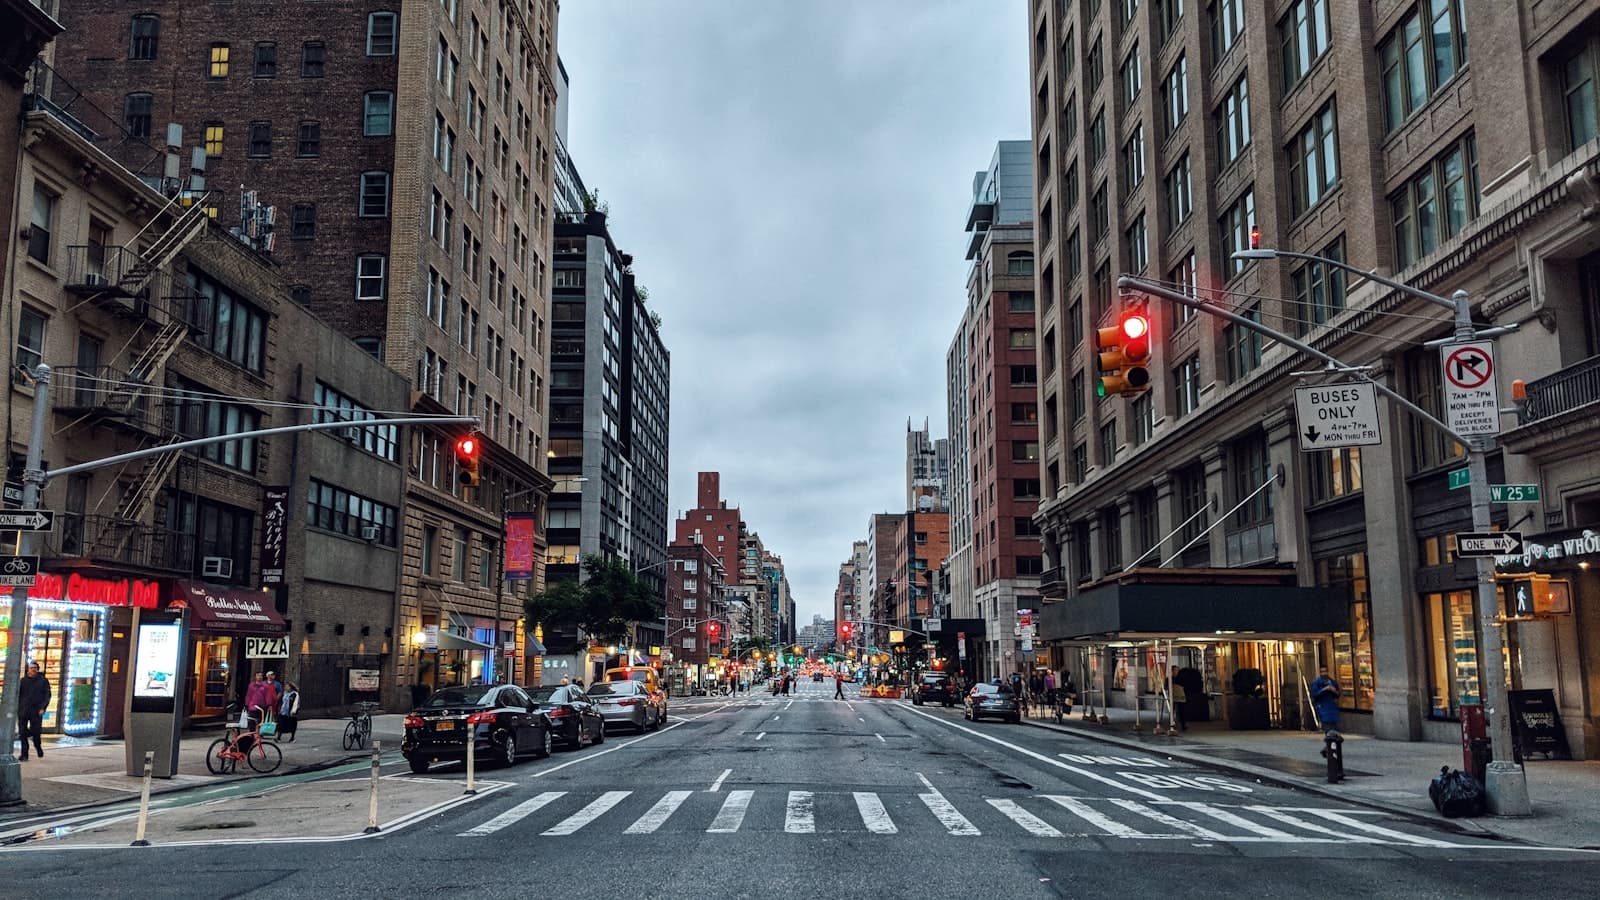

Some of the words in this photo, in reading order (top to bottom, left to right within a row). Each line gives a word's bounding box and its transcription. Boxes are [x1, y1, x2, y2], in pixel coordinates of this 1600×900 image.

[1310, 389, 1359, 404] BUSES
[1318, 405, 1355, 420] ONLY
[1460, 411, 1485, 419] EXCEPT
[1454, 418, 1492, 426] DELIVERIES
[1324, 433, 1342, 441] MON
[1362, 430, 1376, 439] FRI
[1454, 472, 1460, 485] 7
[1491, 487, 1501, 500] W
[1507, 487, 1523, 500] 25
[0, 515, 16, 524] ONE
[25, 516, 43, 526] WAY
[1466, 540, 1486, 550] ONE
[1493, 539, 1513, 549] WAY
[0, 575, 13, 585] IKE
[16, 575, 34, 585] LANE
[67, 573, 128, 607] Gourmet
[247, 638, 288, 655] PIZZA
[543, 659, 568, 668] SEA
